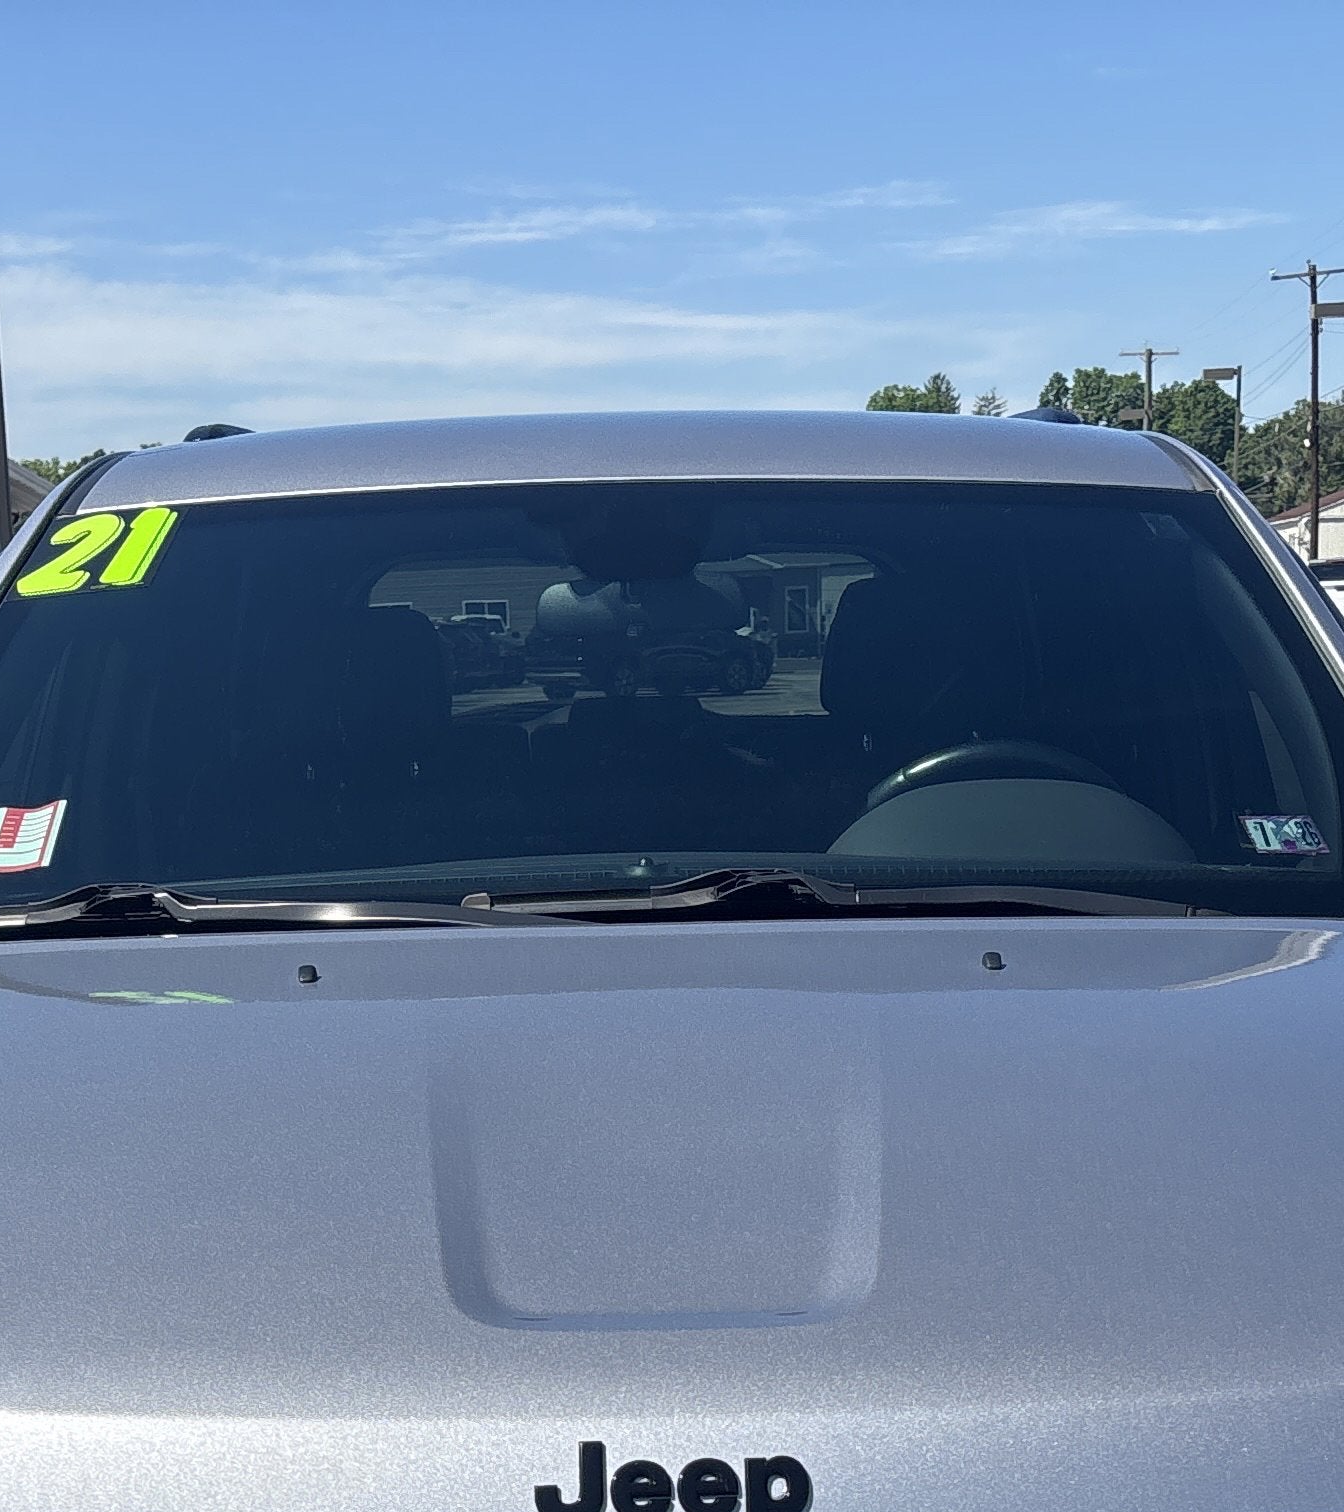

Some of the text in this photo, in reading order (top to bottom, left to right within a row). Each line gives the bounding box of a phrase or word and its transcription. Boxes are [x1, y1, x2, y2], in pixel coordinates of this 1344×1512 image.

[17, 507, 178, 597] 21
[1253, 820, 1322, 848] 7 26
